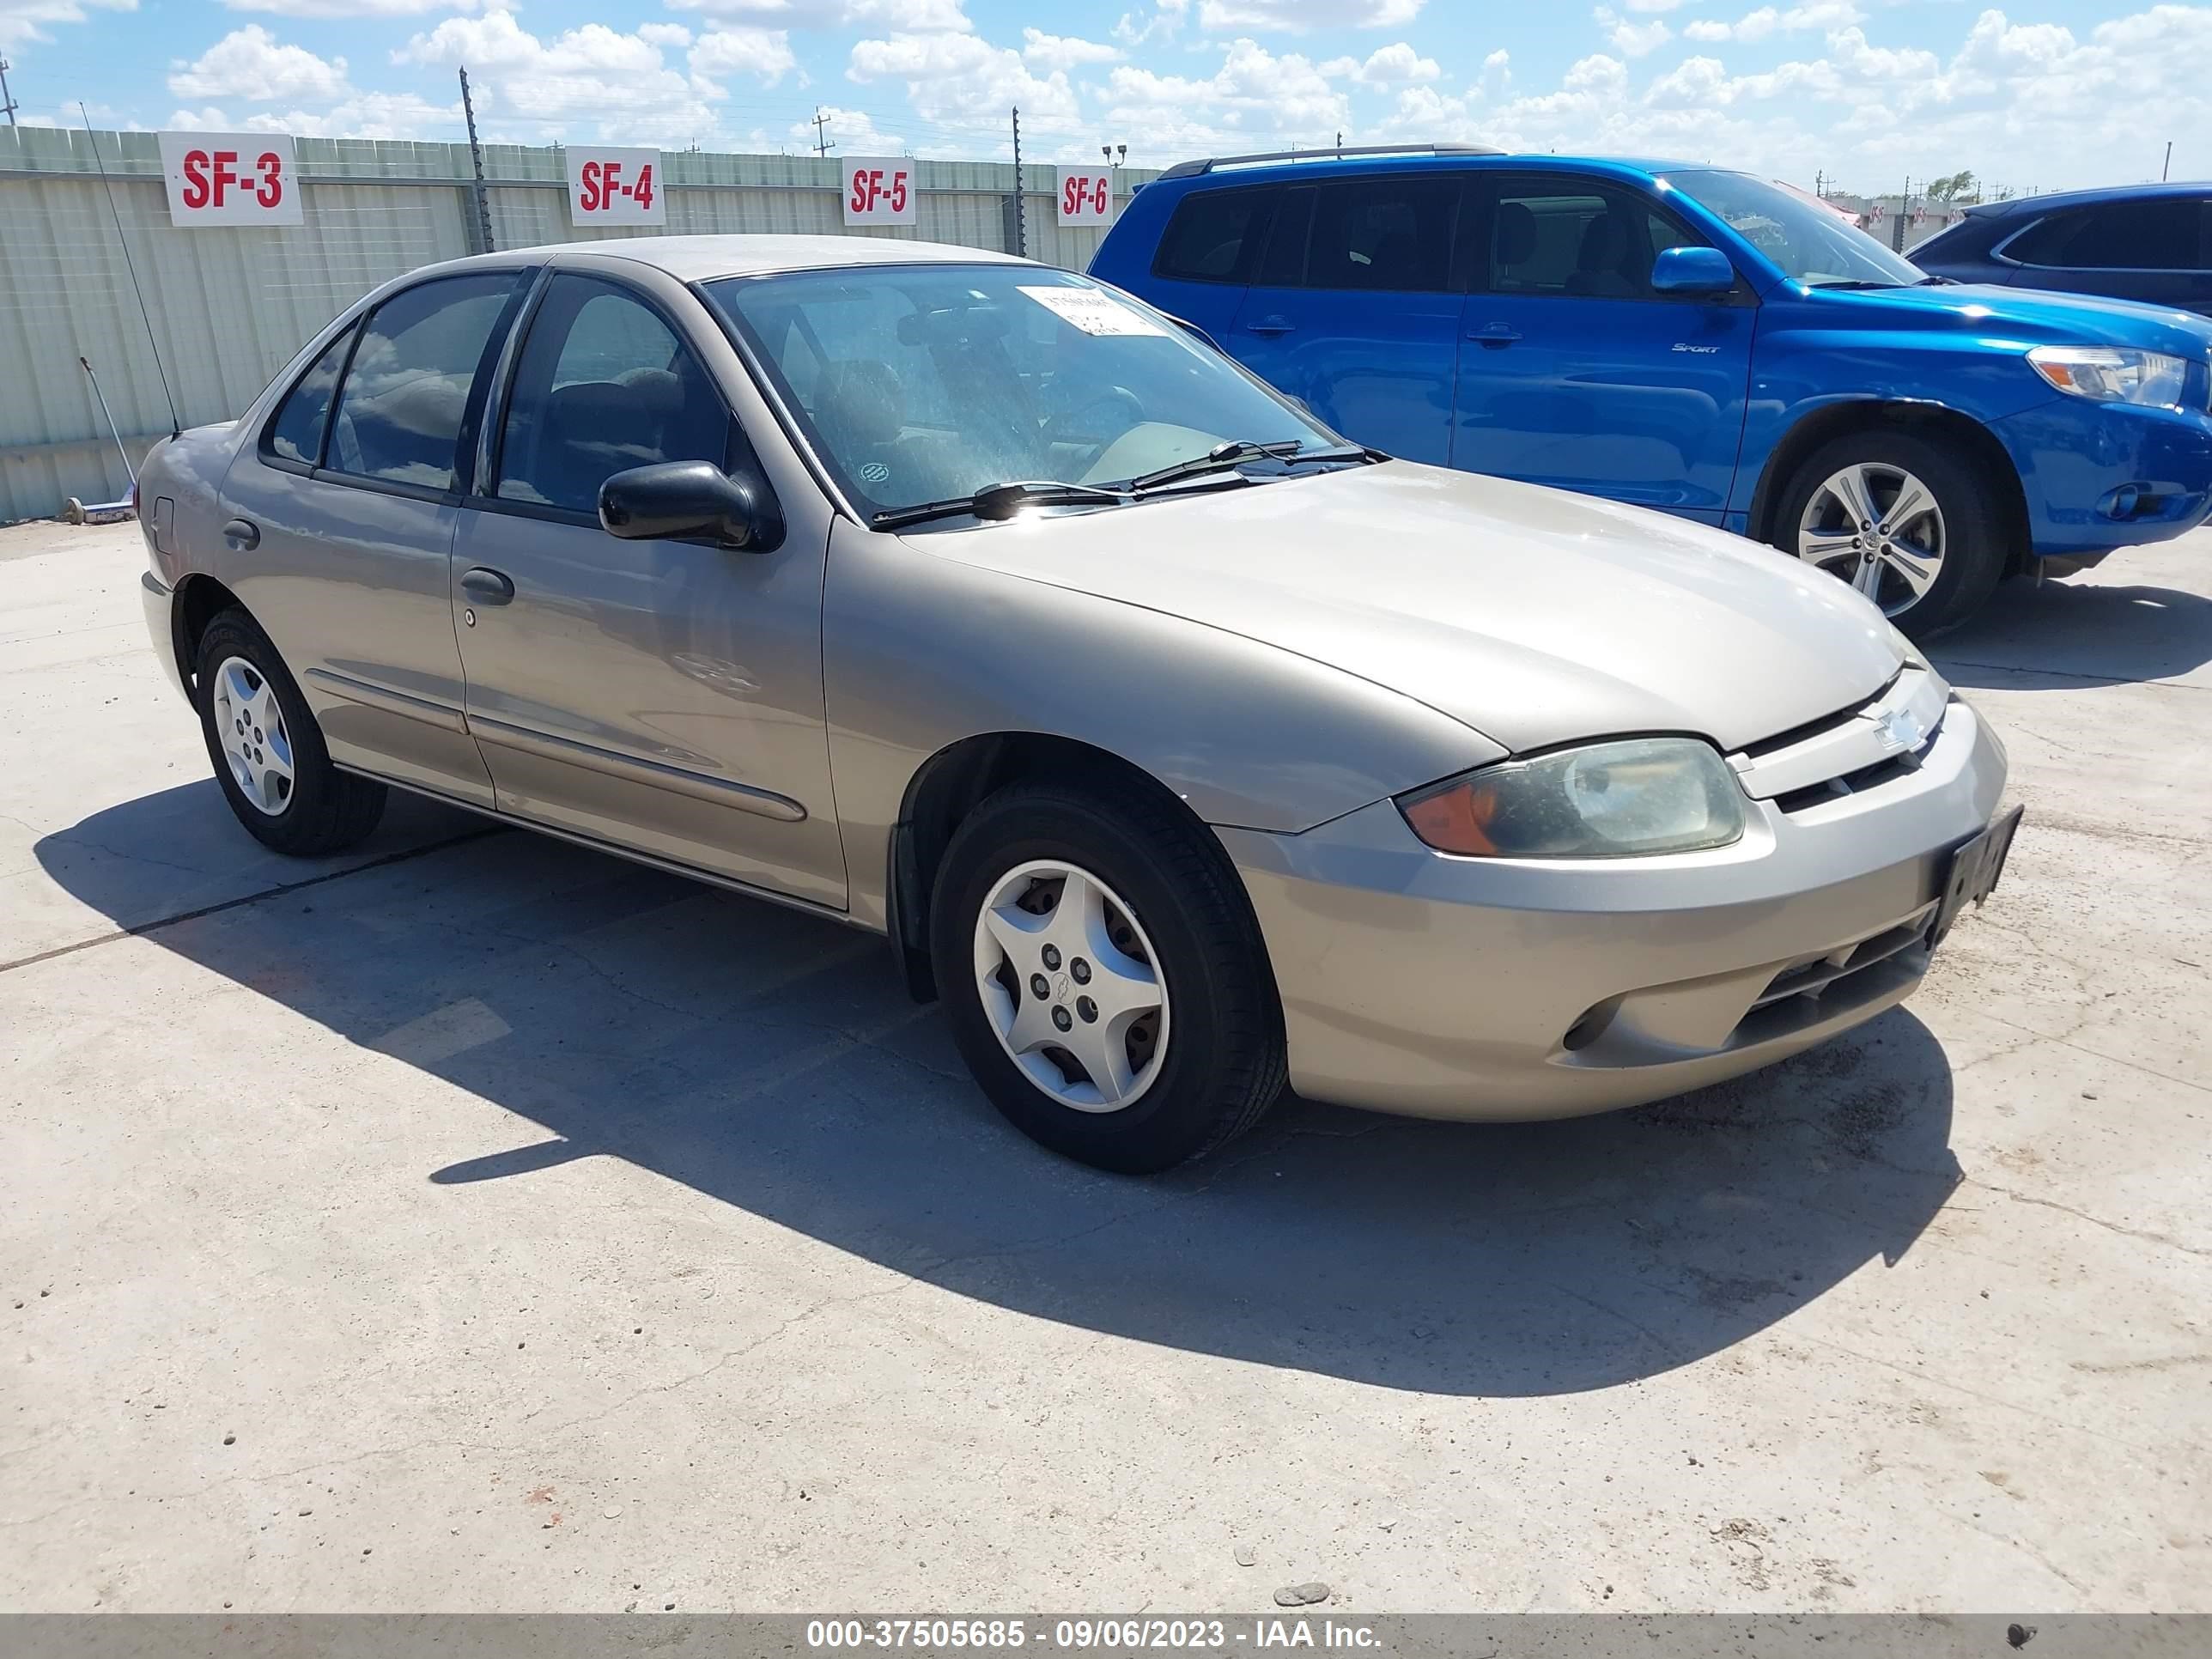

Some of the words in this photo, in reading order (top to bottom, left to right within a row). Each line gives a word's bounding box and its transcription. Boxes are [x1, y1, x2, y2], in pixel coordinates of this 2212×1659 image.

[183, 150, 282, 210] SF-3
[580, 161, 653, 211] SF-4
[850, 170, 908, 213] SF-5
[1063, 177, 1108, 215] SF-6
[1671, 343, 1721, 354] SPORT
